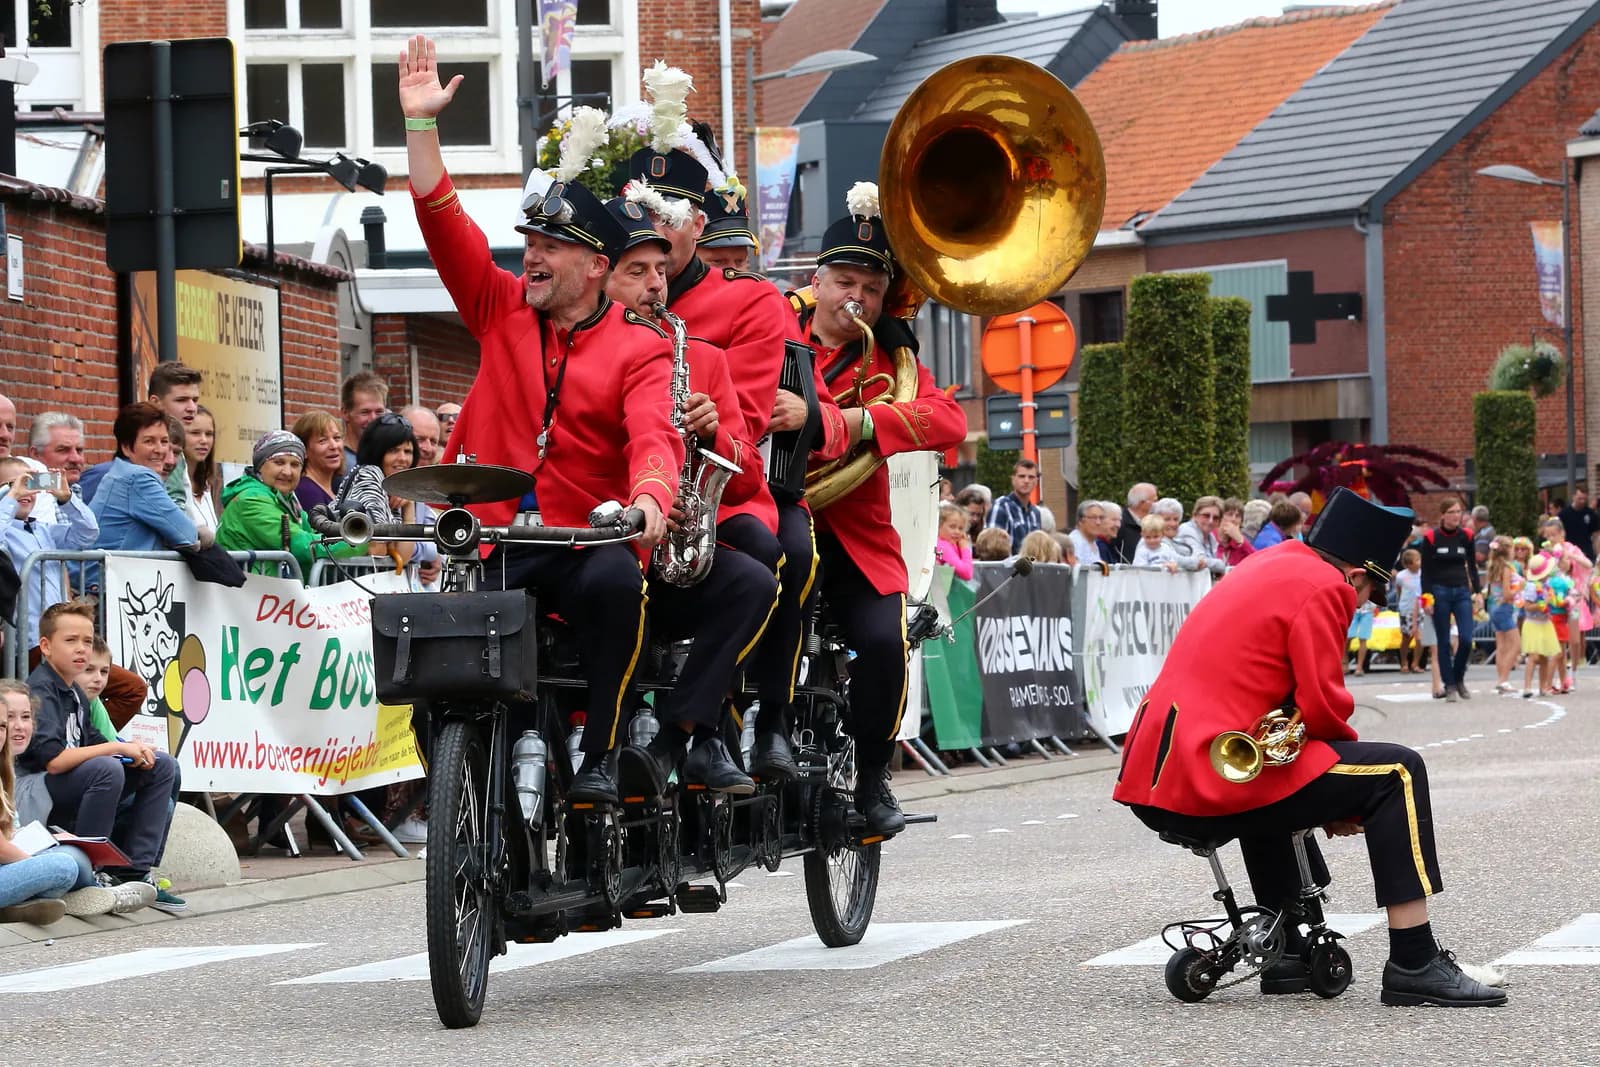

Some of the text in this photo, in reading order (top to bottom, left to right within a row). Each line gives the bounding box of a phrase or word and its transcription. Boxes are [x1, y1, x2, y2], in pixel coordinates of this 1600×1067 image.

[176, 281, 265, 351] ERBERG DE KEIZER
[221, 625, 301, 707] Het
[193, 730, 382, 786] www.boerenijsje.be
